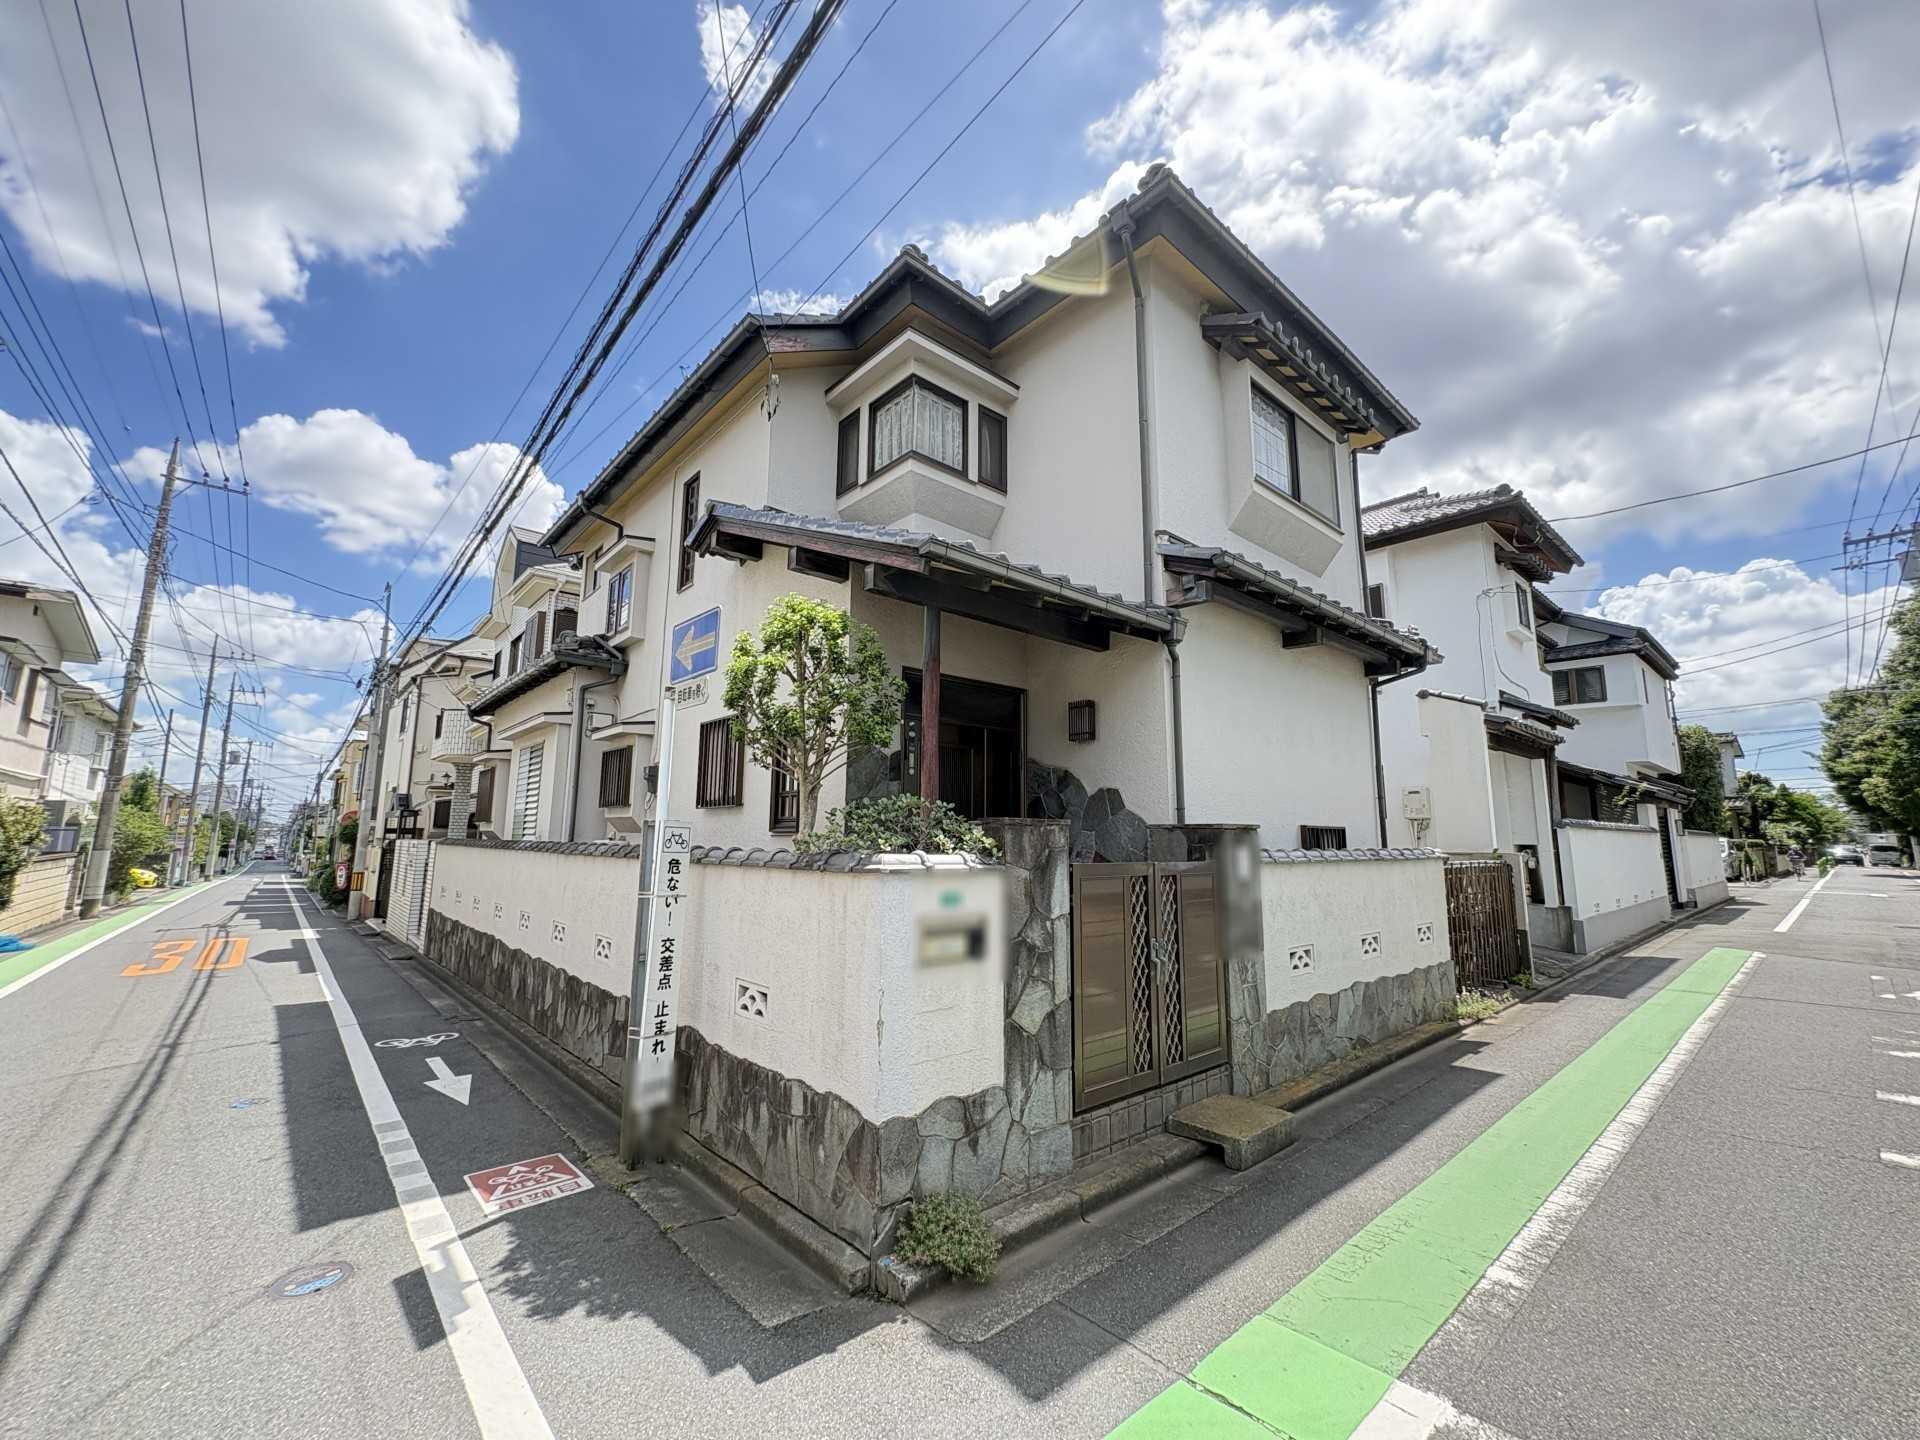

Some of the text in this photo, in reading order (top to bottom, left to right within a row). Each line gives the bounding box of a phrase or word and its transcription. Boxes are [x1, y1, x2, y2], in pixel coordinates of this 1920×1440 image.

[665, 858, 682, 926] 危ない！
[120, 937, 250, 977] 30
[657, 937, 675, 990] 交差点
